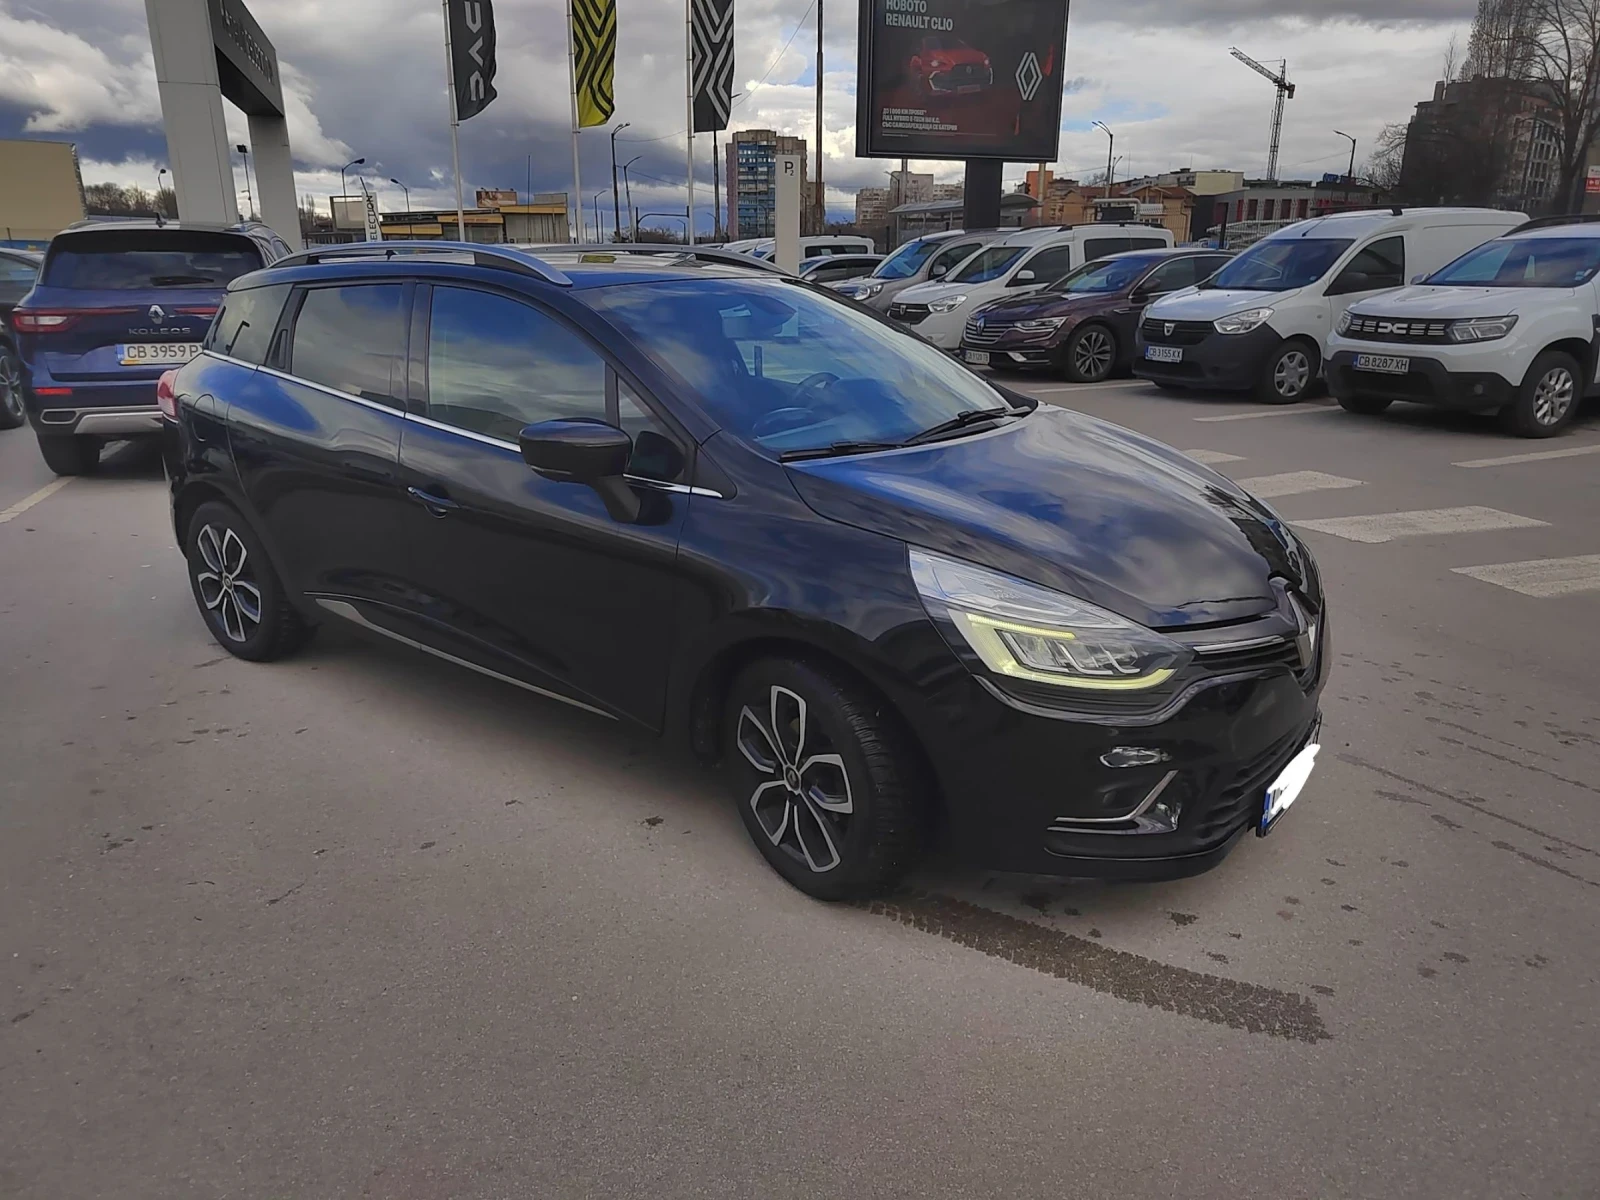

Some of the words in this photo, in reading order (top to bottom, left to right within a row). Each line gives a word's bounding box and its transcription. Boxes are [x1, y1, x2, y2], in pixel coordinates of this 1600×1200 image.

[885, 13, 930, 29] RENAULT
[930, 17, 953, 31] CLIO
[128, 327, 191, 335] KOLEOS
[127, 345, 147, 359] CB
[150, 344, 186, 358] 3959
[1358, 356, 1370, 366] CB
[1371, 357, 1394, 369] 8287
[1394, 359, 1408, 370] XH
